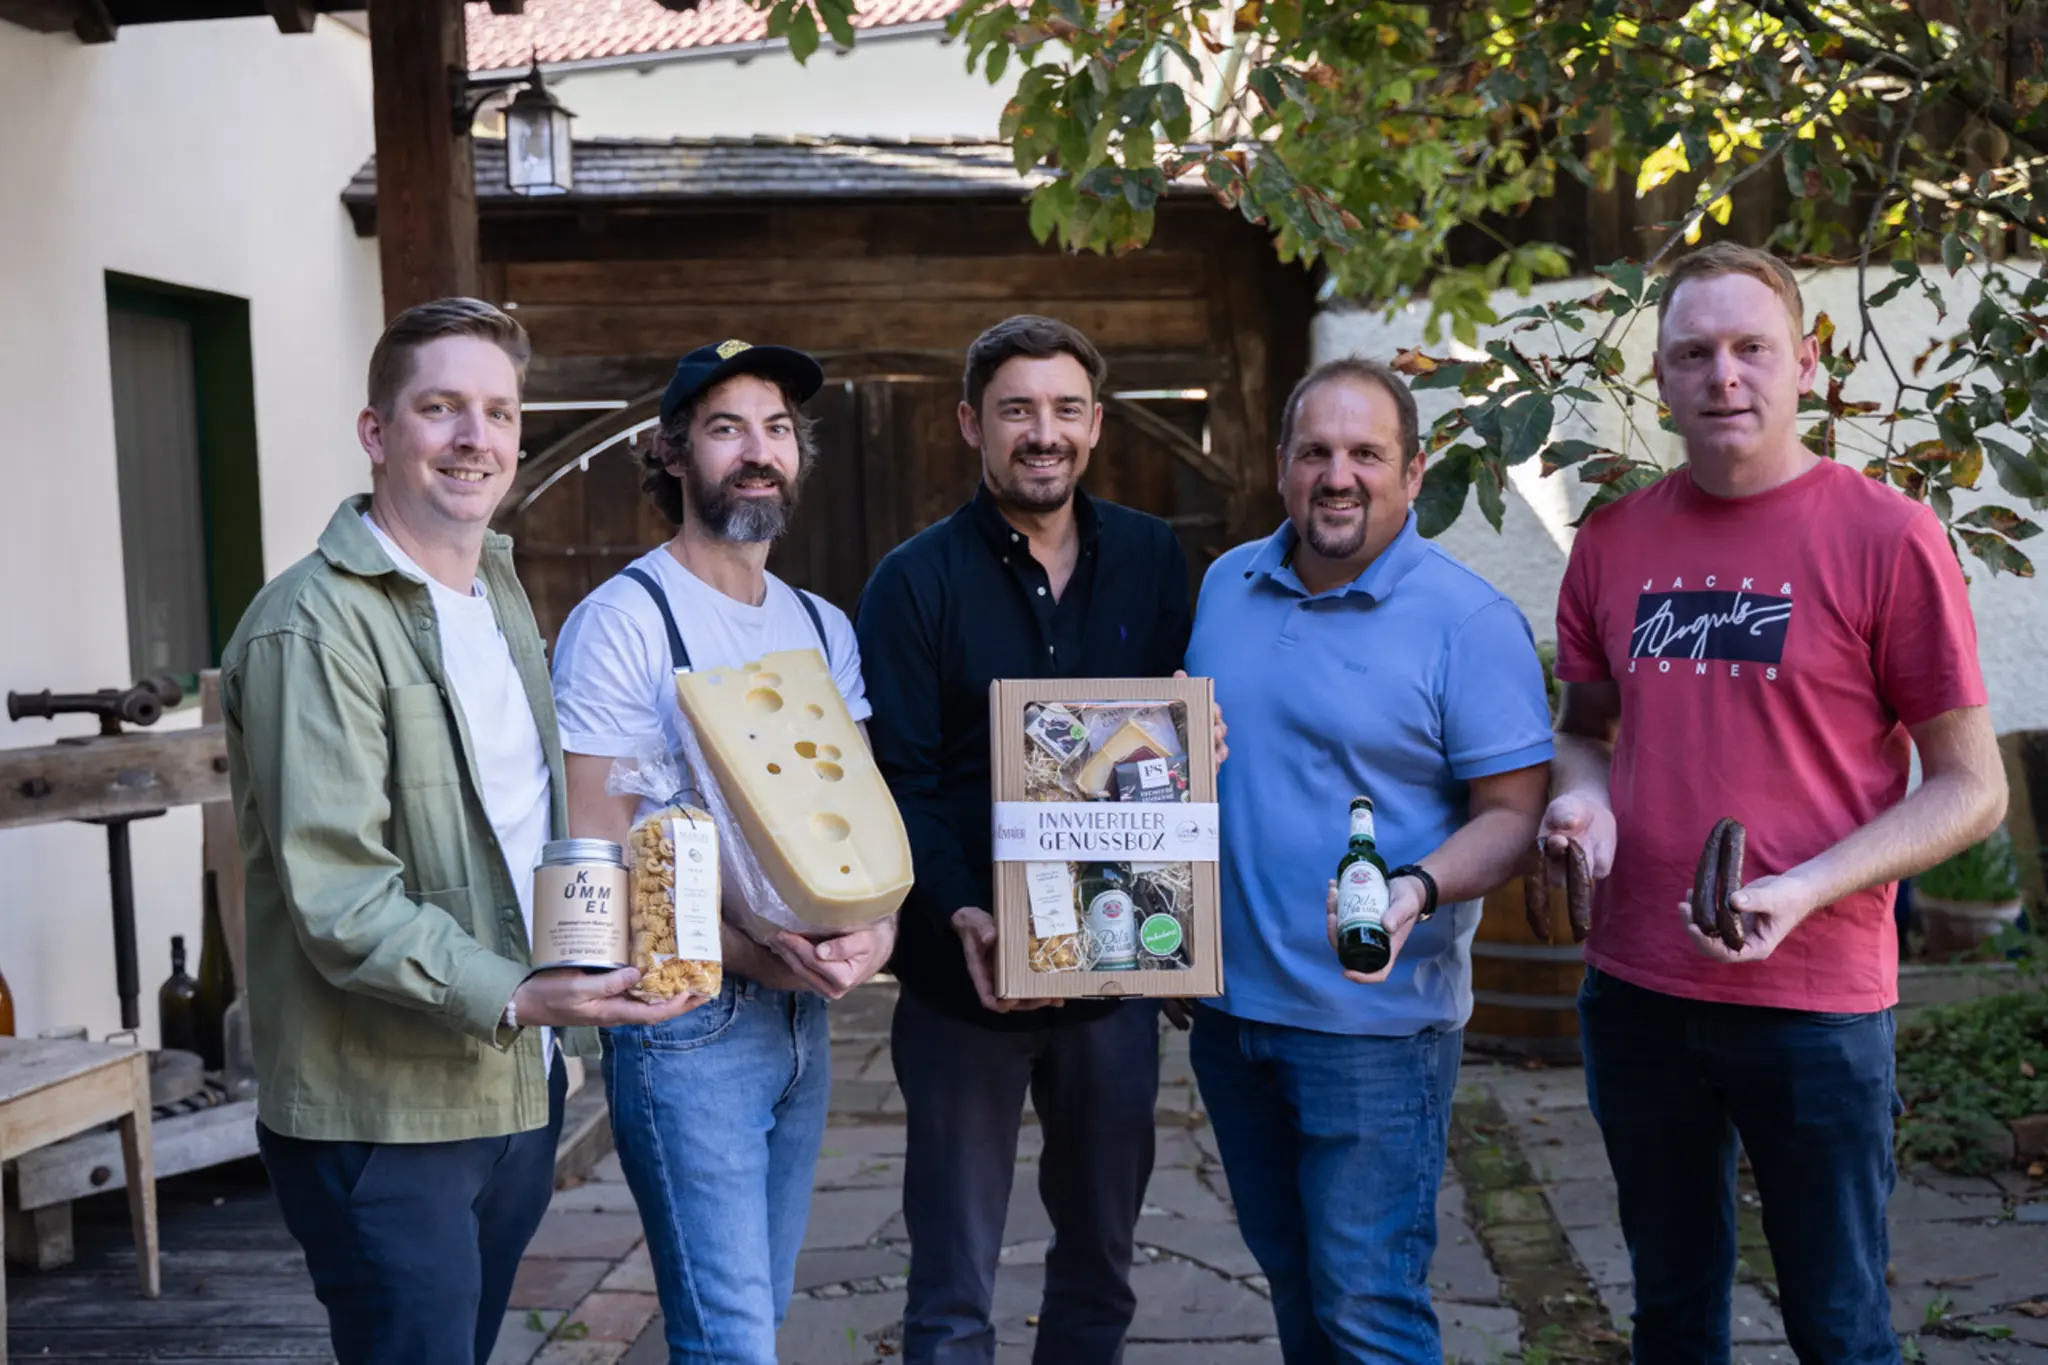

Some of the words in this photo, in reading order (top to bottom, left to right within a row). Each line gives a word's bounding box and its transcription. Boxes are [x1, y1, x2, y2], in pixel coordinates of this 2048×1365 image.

[1642, 574, 1754, 591] JACK
[1780, 582, 1792, 596] &
[1627, 660, 1778, 681] JONES
[1039, 811, 1166, 830] INNVIERTLER
[1039, 831, 1166, 851] GENUSSBOX
